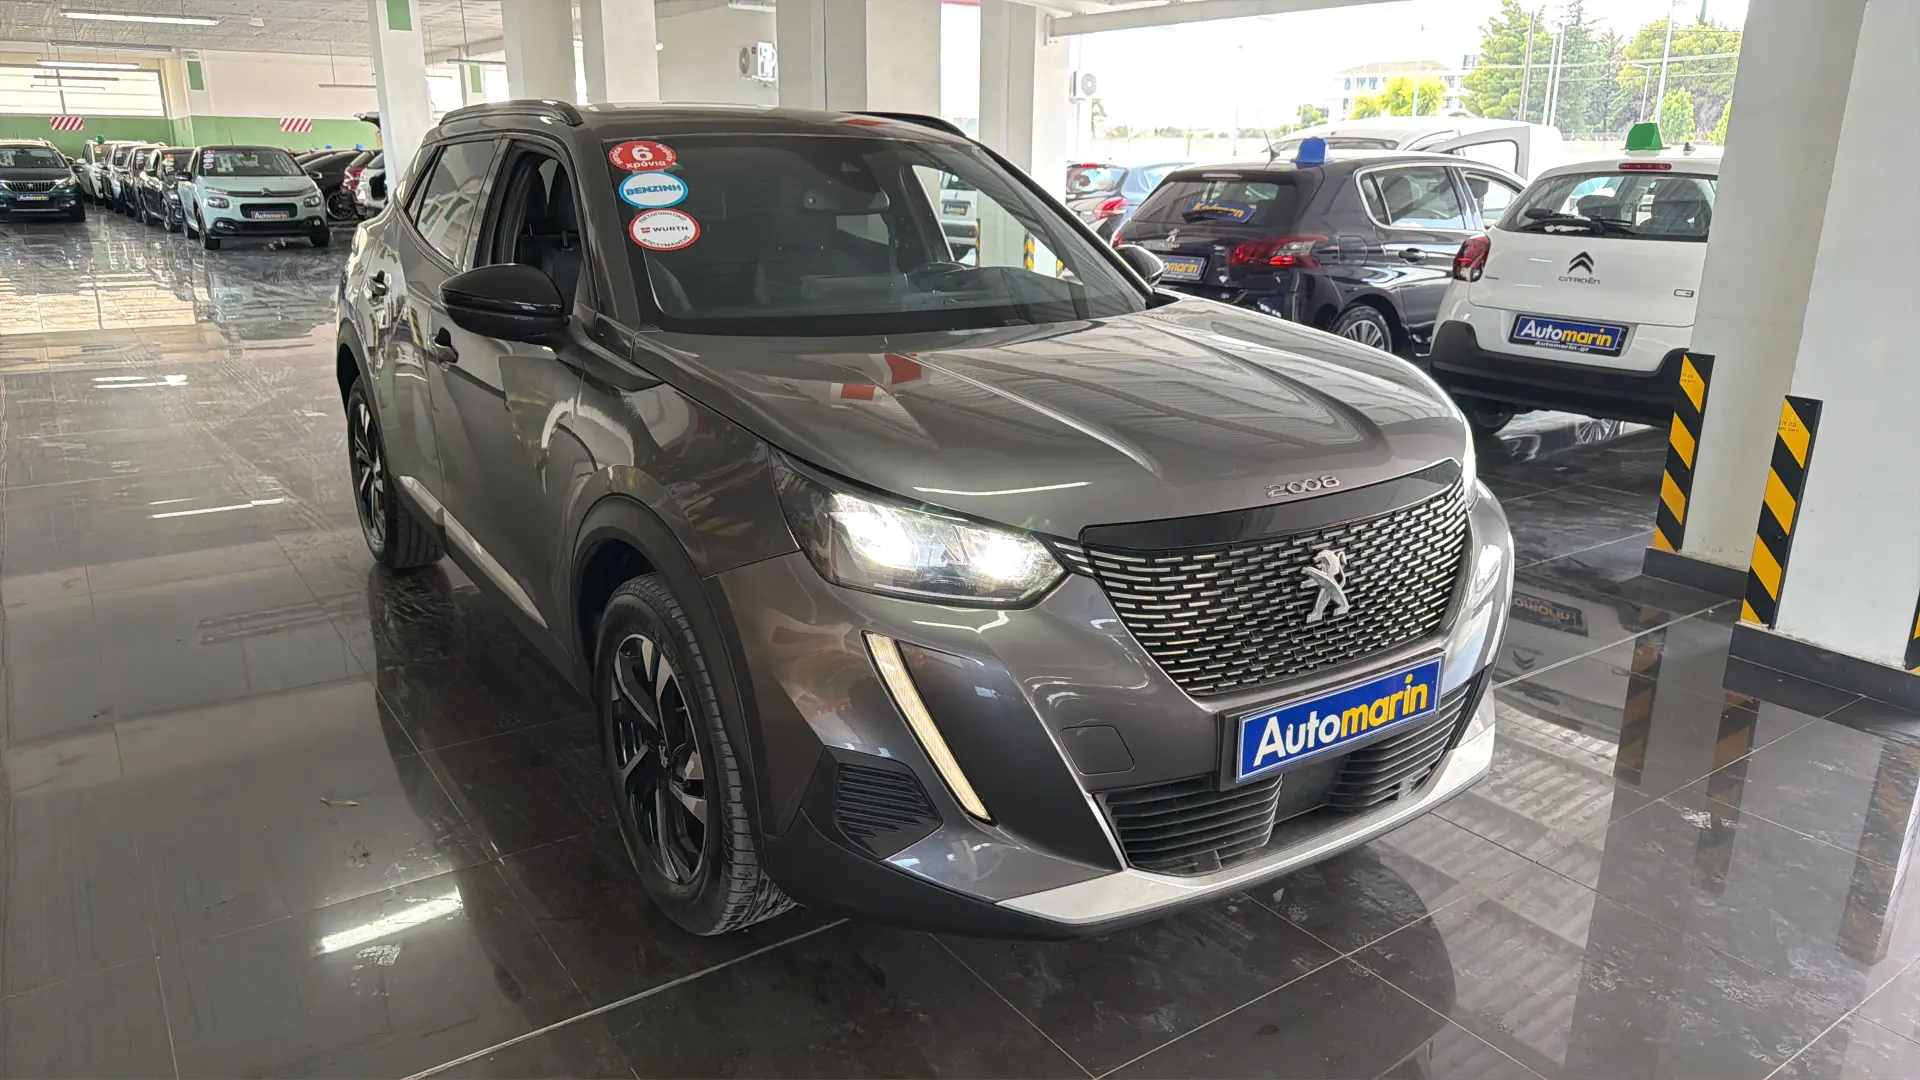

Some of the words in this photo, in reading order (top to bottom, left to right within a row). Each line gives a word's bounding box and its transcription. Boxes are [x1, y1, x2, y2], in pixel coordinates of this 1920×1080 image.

[631, 146, 654, 161] 6
[625, 160, 667, 169] χρόνια
[625, 184, 682, 196] ΒΕΝΖΙΝΗ
[1673, 288, 1695, 298] C3
[1520, 319, 1613, 347] Automarin
[1263, 475, 1341, 498] 2008
[1253, 673, 1429, 767] Automarin
